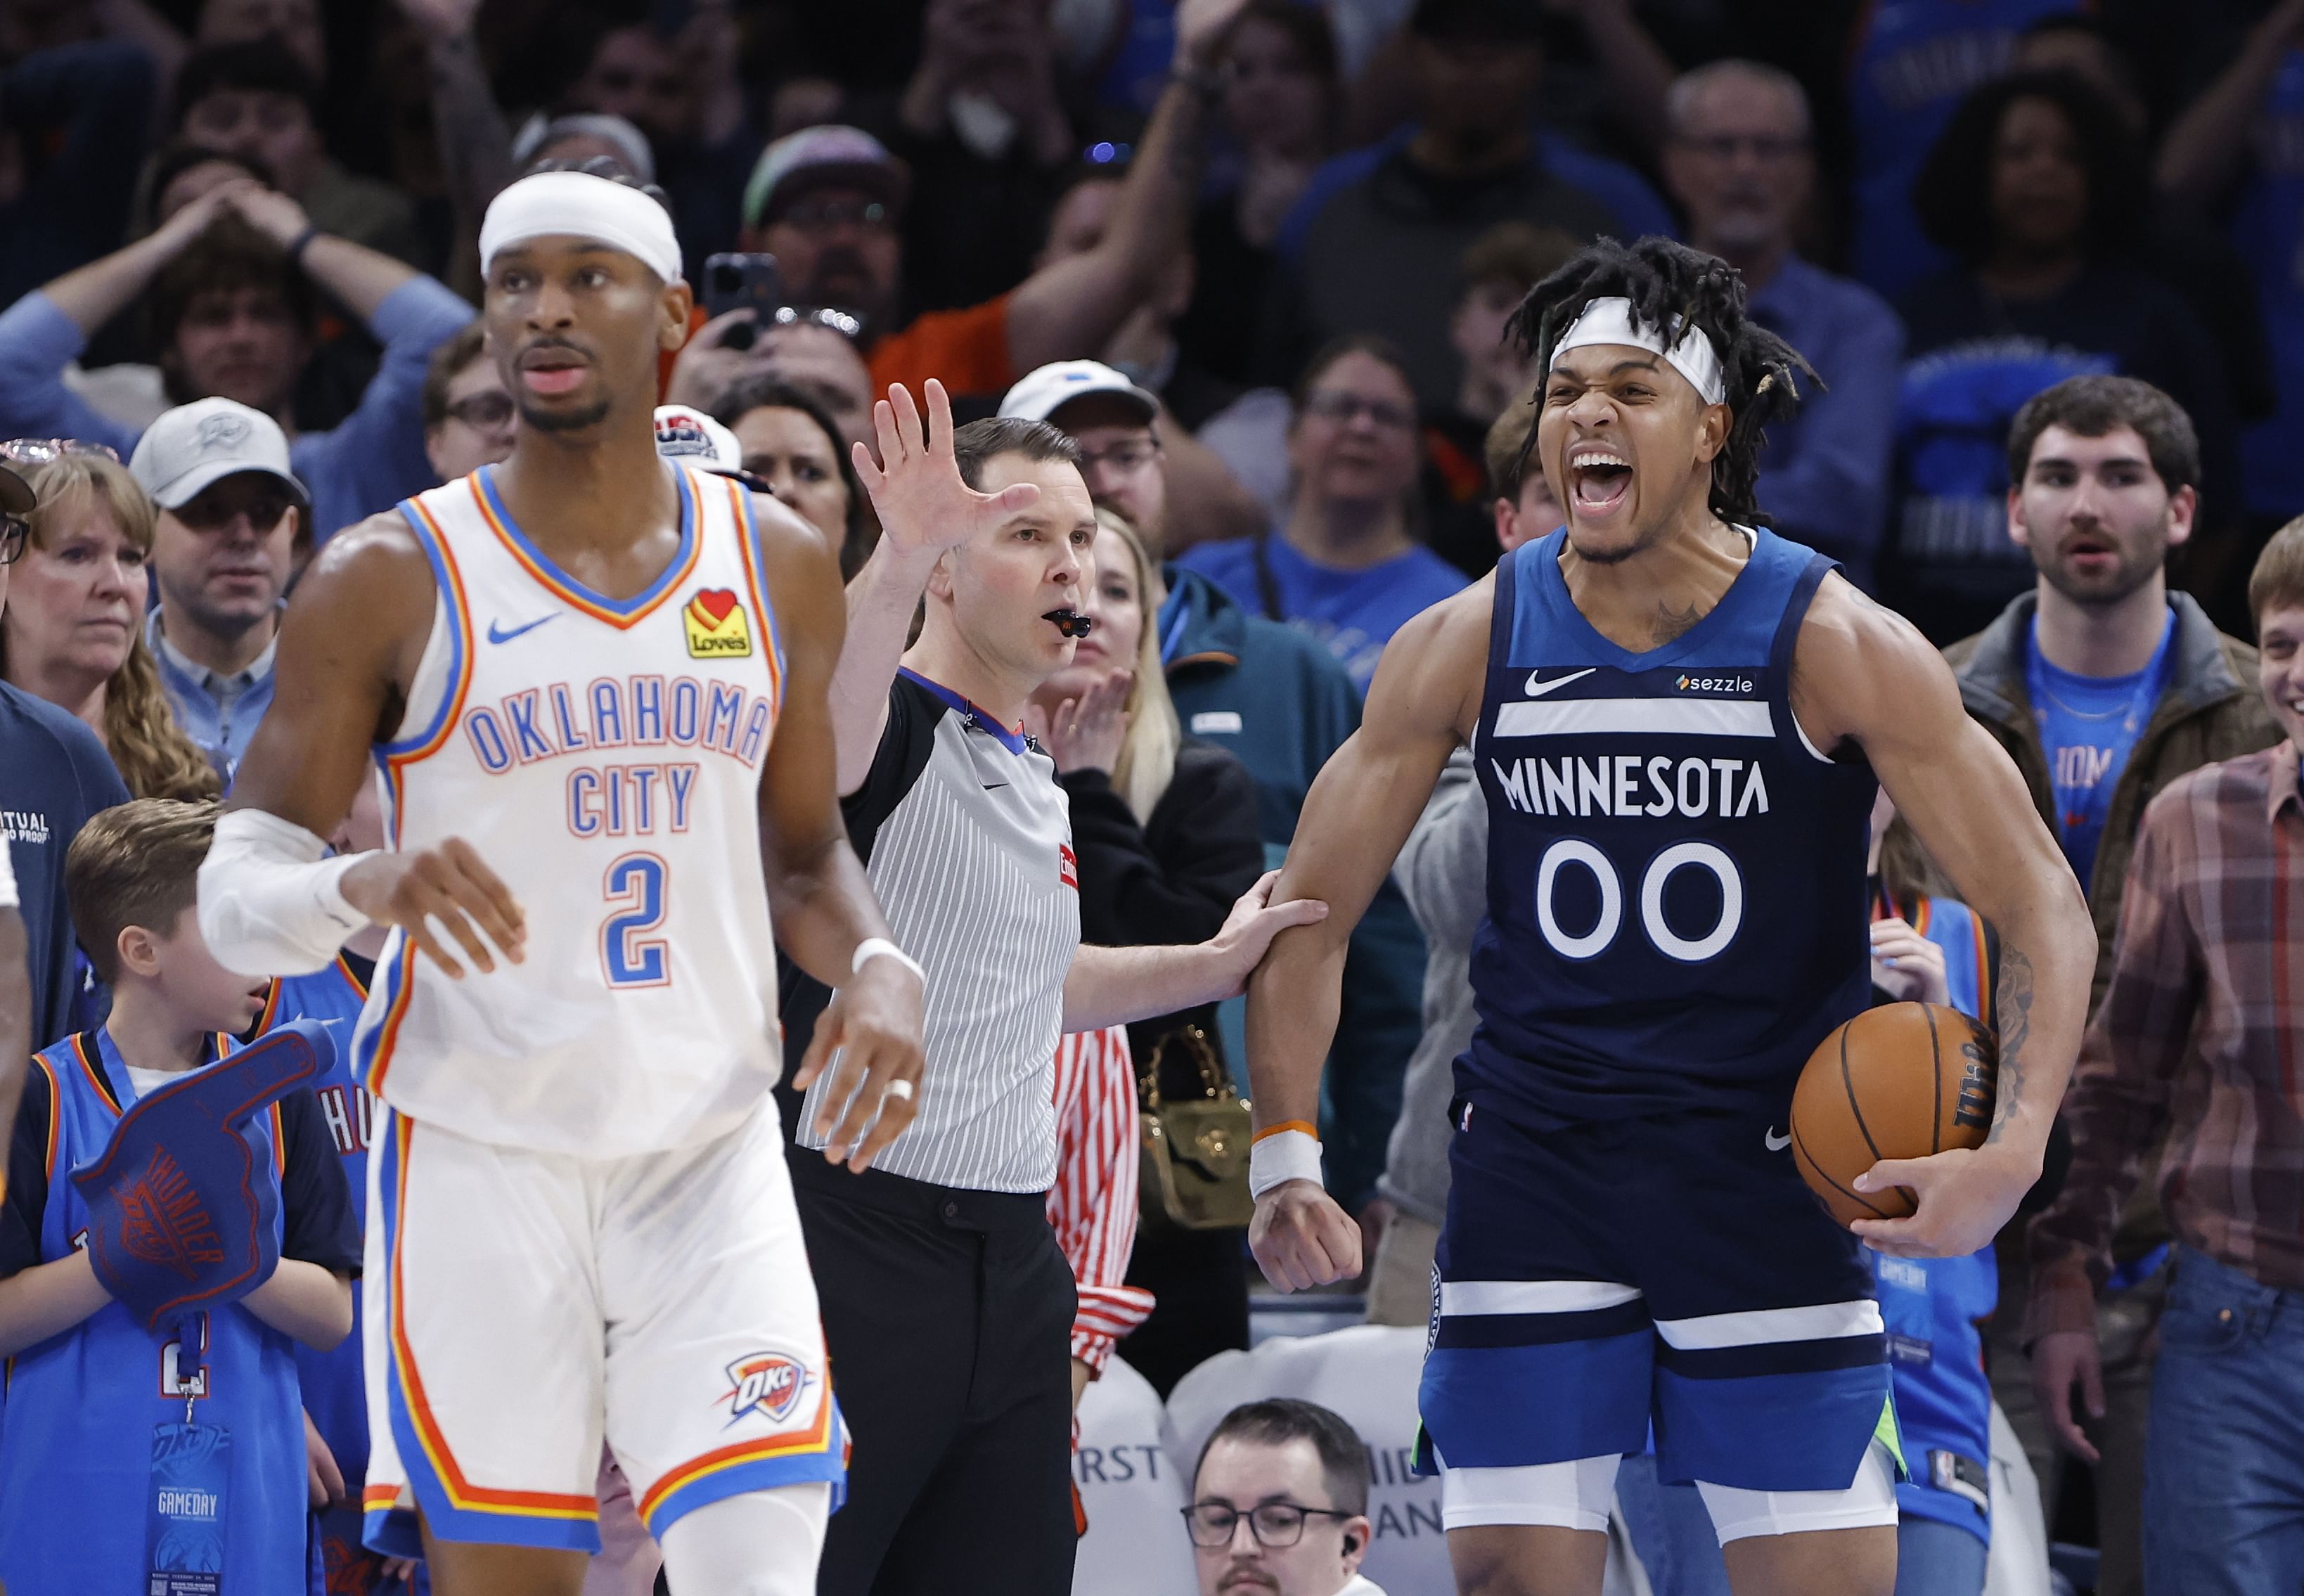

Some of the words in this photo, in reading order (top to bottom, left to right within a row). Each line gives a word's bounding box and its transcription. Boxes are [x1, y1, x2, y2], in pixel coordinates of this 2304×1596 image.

[691, 630, 747, 650] Love's
[1690, 676, 1753, 693] sezzle
[463, 675, 772, 776] OKLAHOMA
[567, 763, 700, 839] CITY
[1491, 756, 1769, 818] MINNESOTA
[598, 849, 672, 990] 2
[1536, 837, 1744, 963] 00
[148, 1142, 224, 1263] THUNDER
[732, 1363, 793, 1415] OKC
[158, 1491, 217, 1517] GAMEDAY
